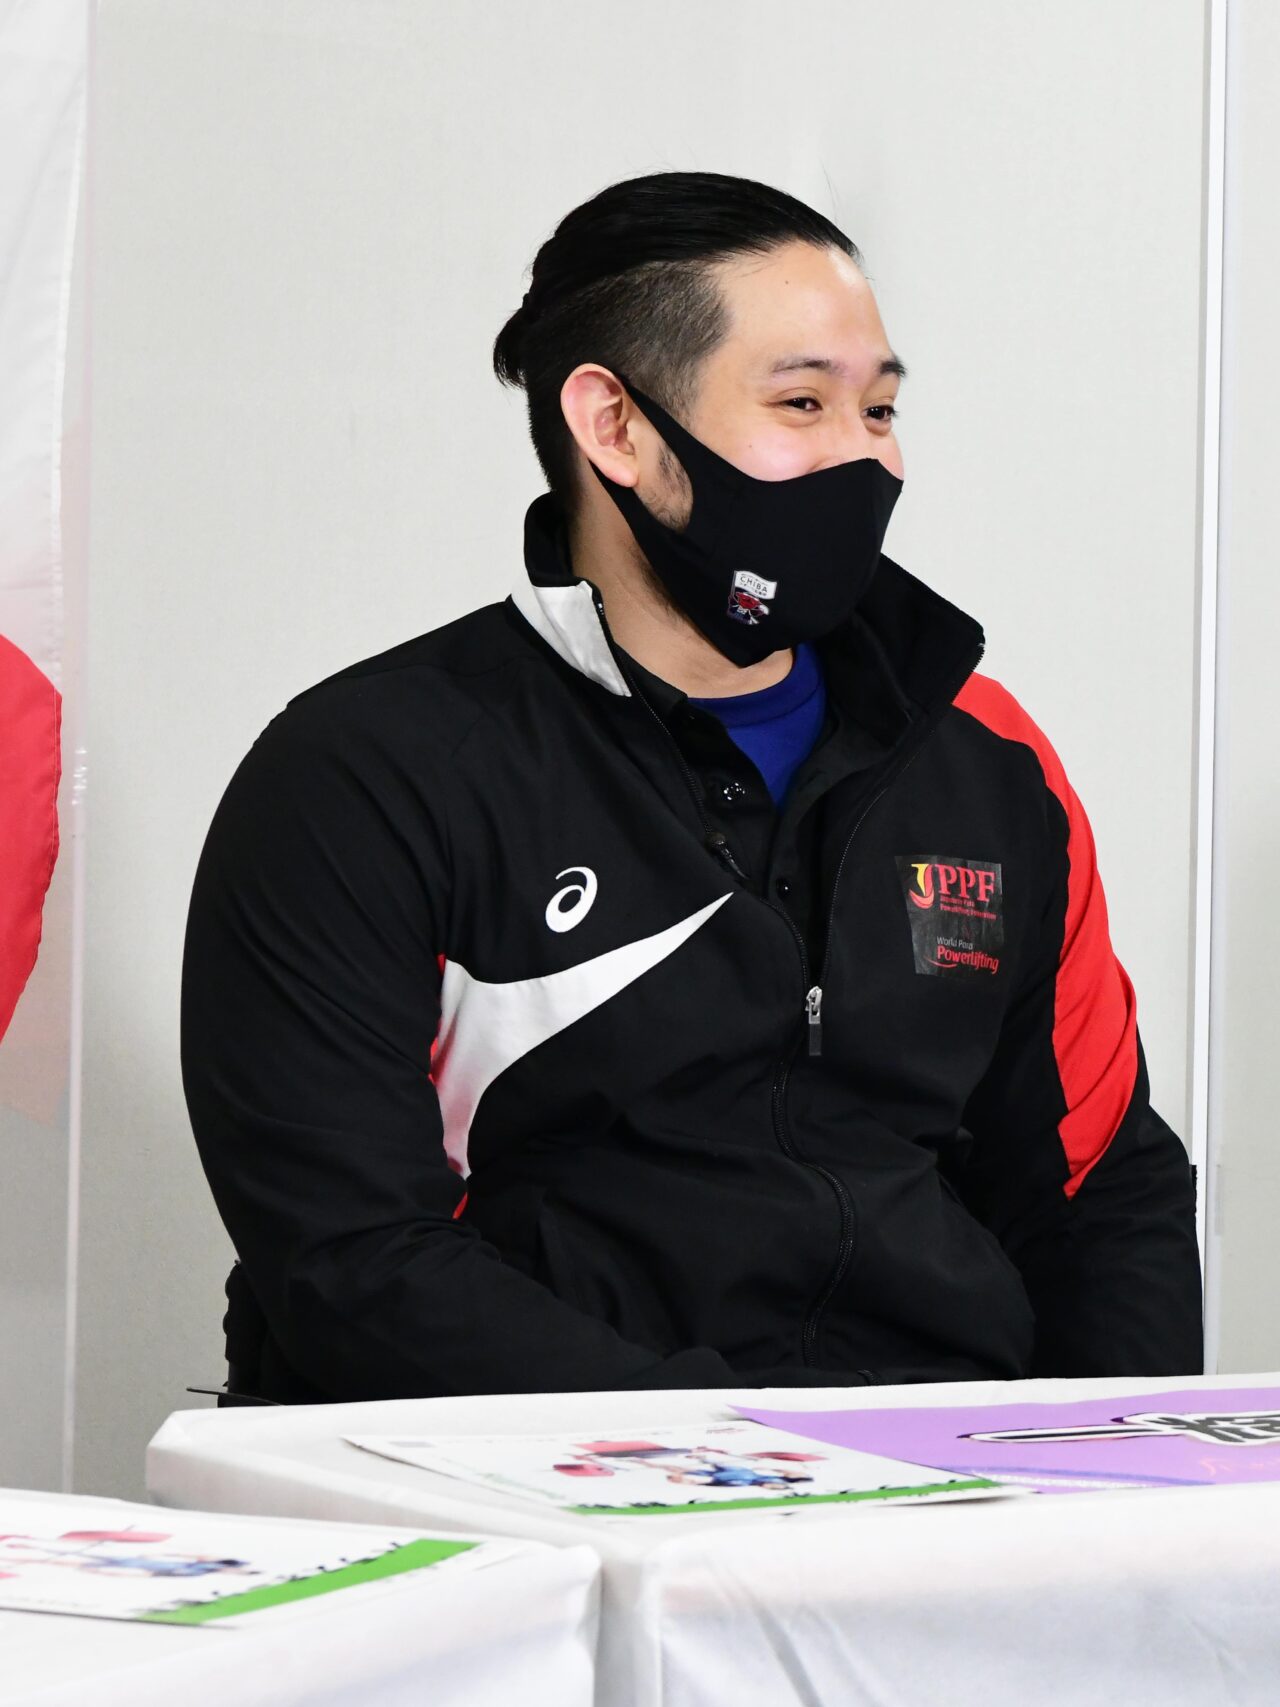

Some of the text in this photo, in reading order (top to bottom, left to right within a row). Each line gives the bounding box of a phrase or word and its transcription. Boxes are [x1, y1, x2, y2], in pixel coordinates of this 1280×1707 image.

[740, 576, 768, 593] CHIBA
[909, 864, 995, 909] JPPF
[937, 936, 974, 951] World Para
[937, 944, 999, 974] Powerlifting
